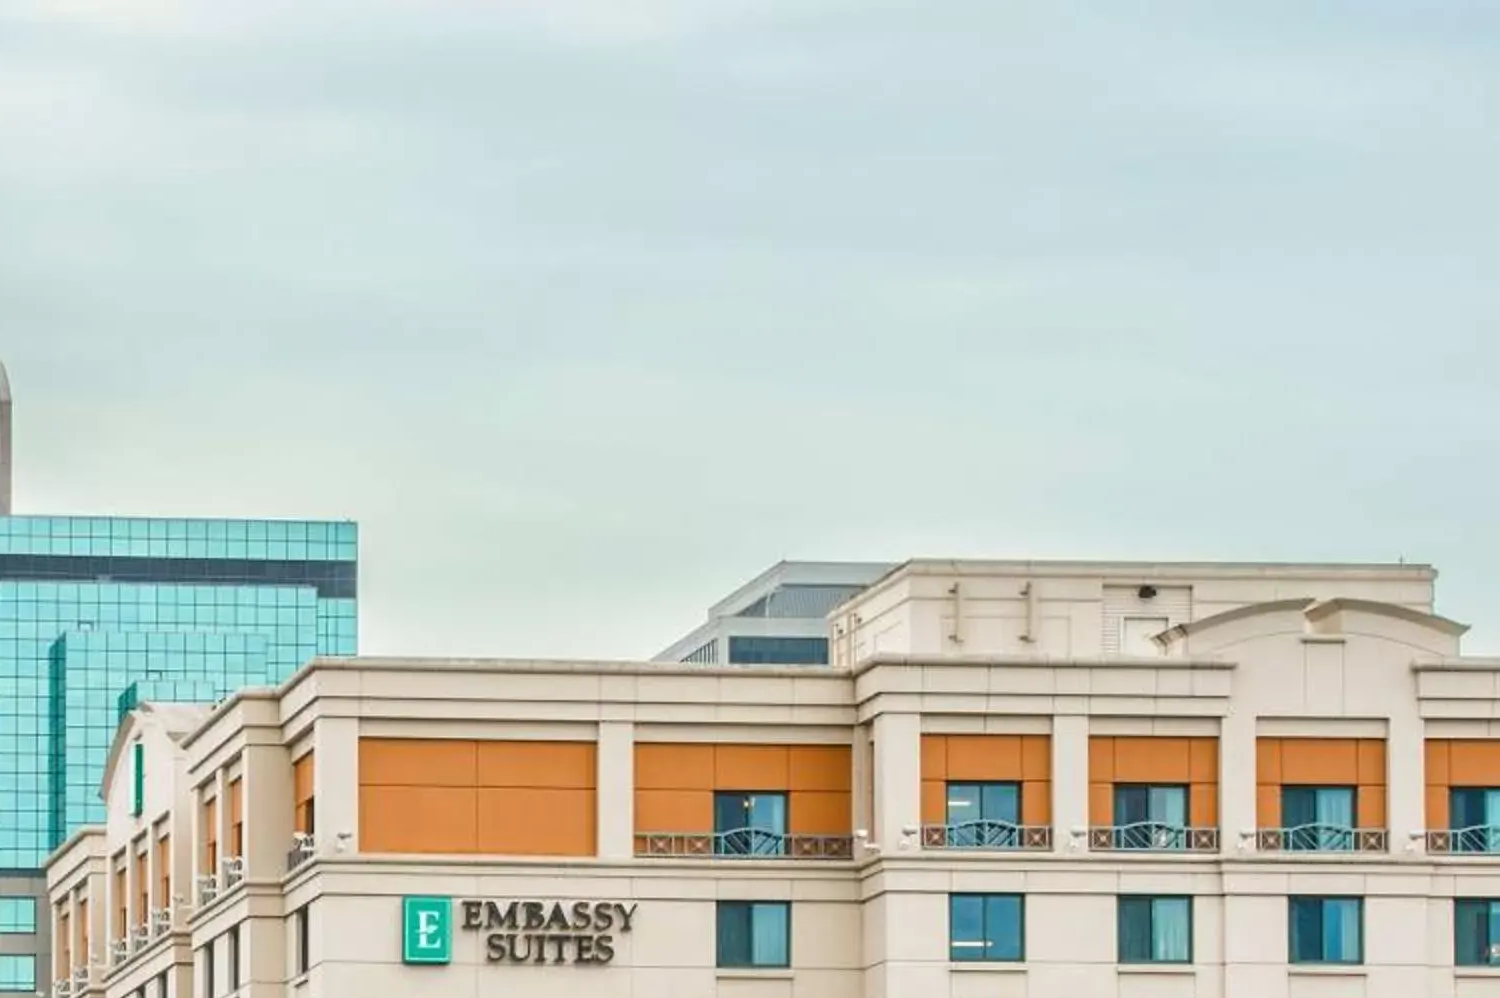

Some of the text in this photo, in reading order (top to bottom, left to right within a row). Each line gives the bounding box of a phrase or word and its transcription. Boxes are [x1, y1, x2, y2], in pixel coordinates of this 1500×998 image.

[417, 910, 442, 948] E
[462, 901, 637, 932] EMBASSY
[487, 934, 614, 965] SUITES
